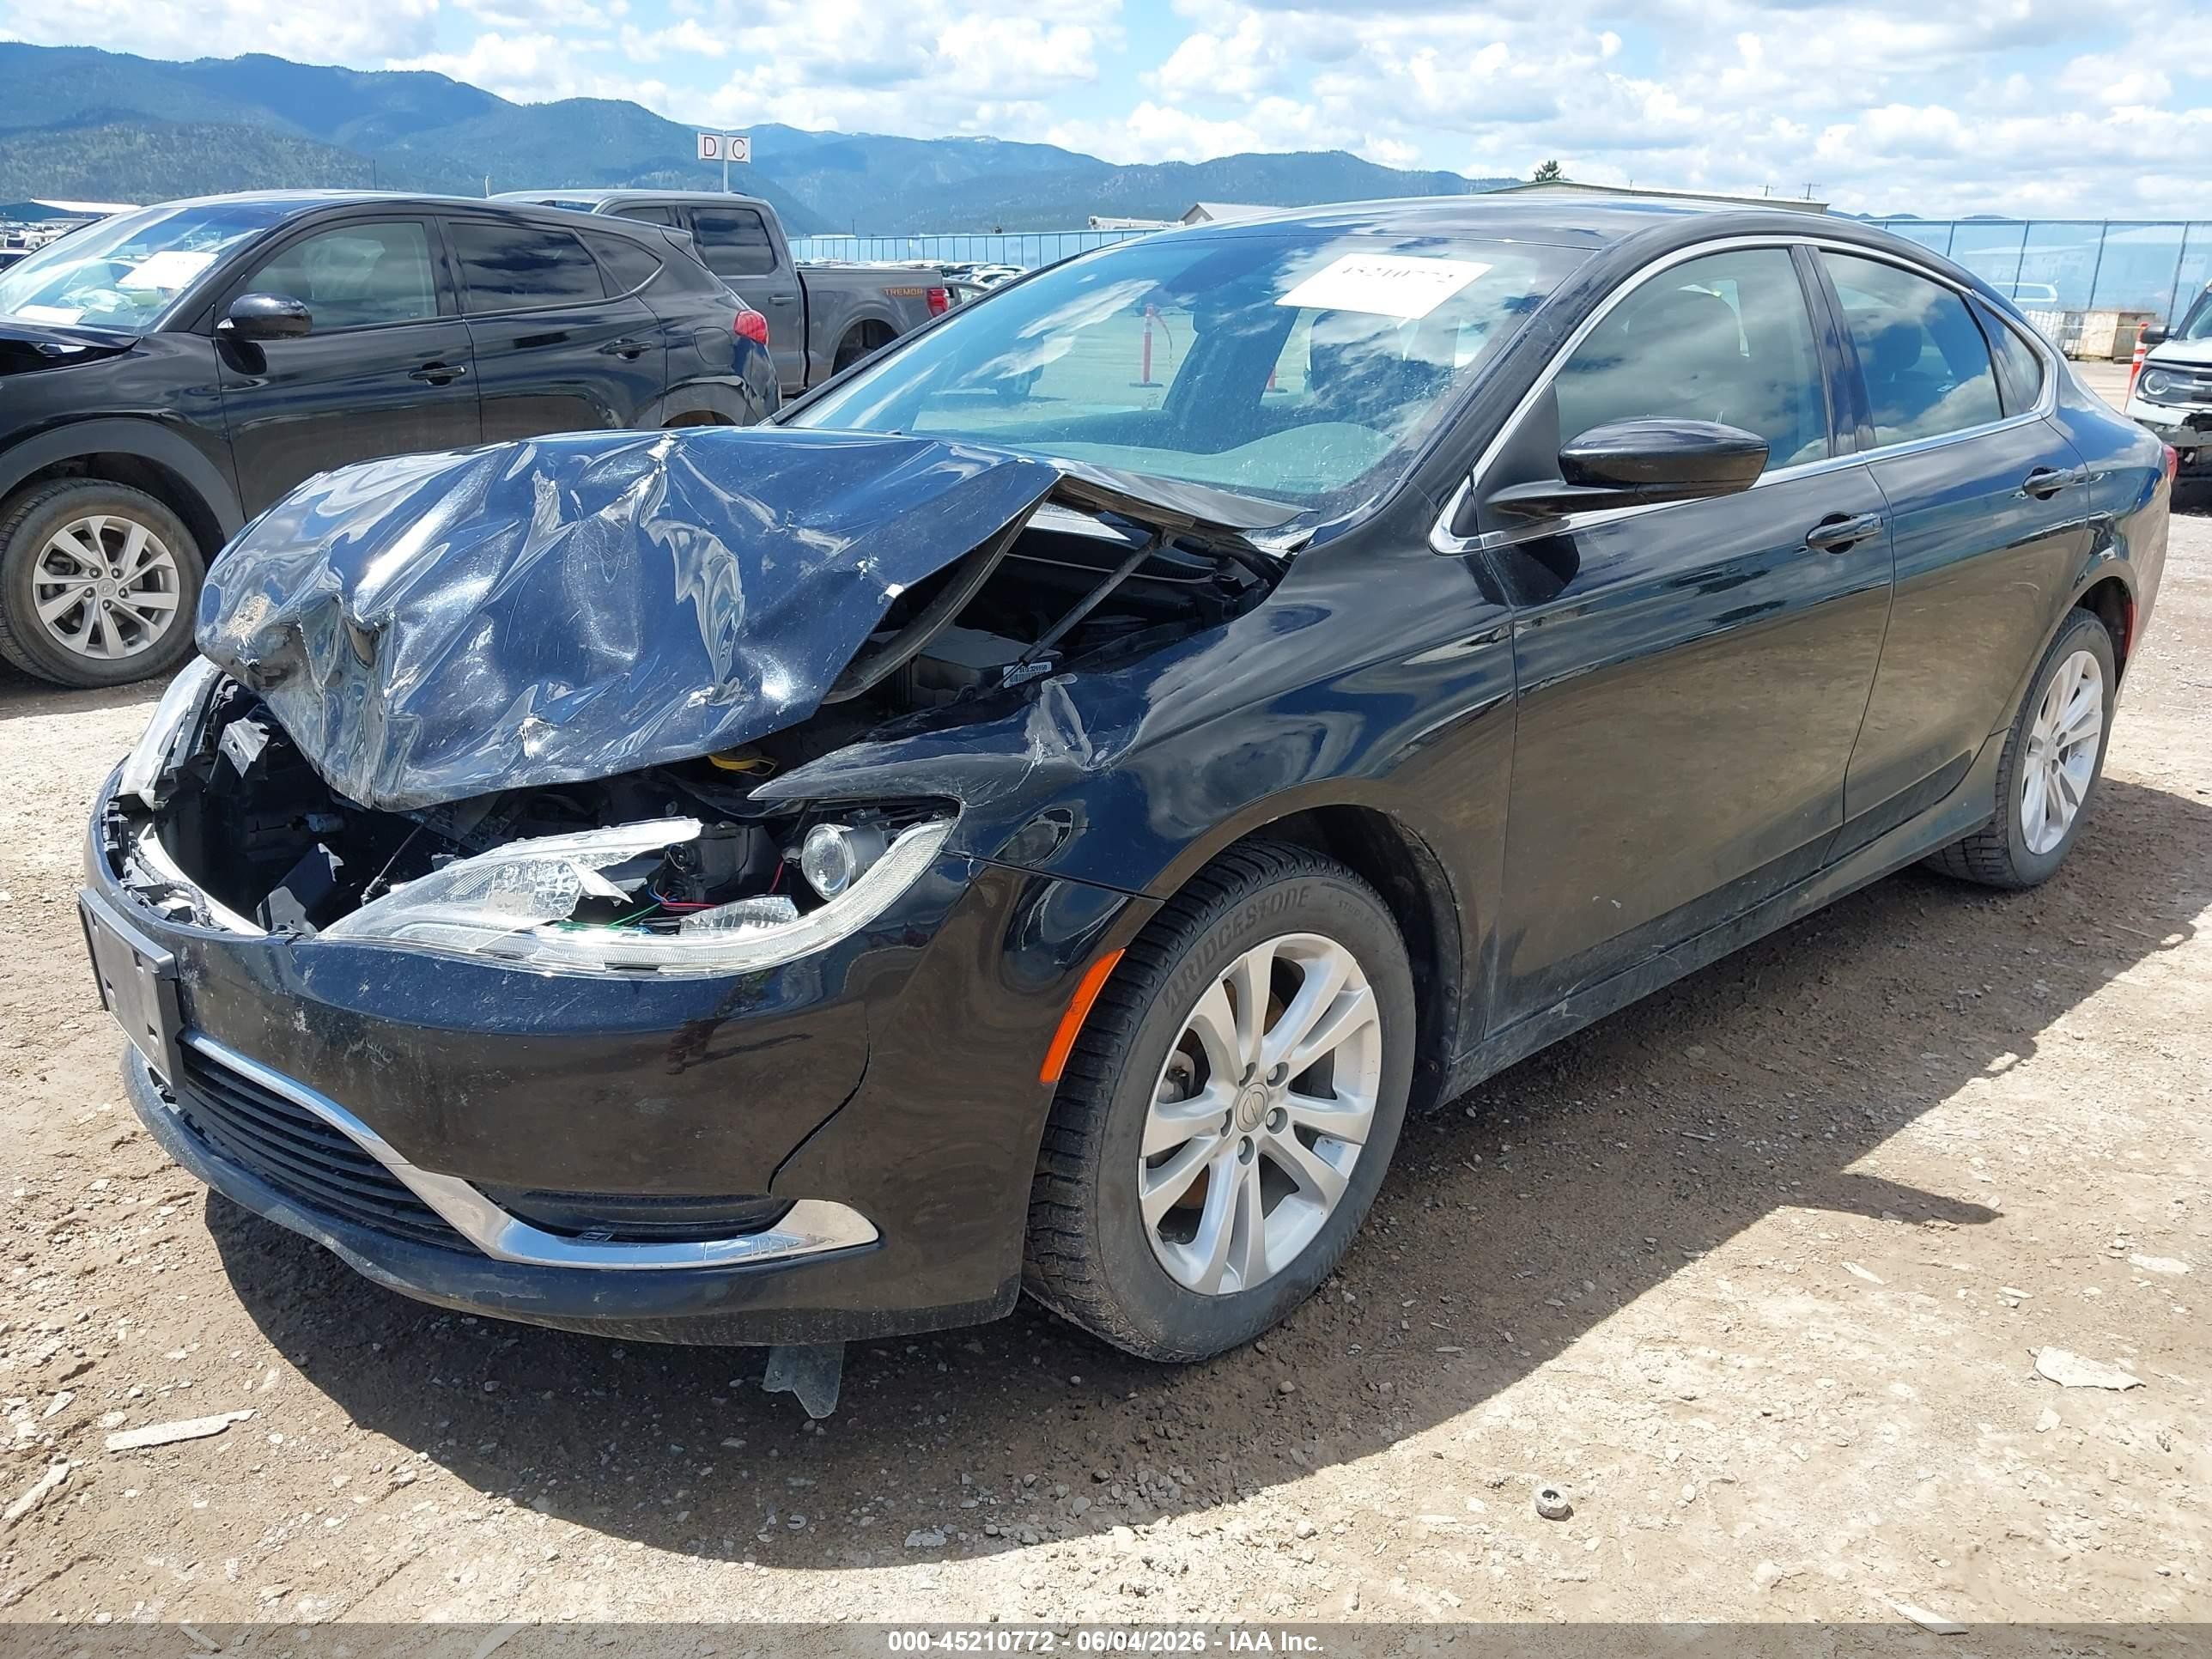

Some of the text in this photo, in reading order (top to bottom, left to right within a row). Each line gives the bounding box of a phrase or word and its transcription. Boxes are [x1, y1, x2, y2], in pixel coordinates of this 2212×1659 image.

[703, 137, 717, 157] D
[732, 139, 745, 160] C
[884, 288, 924, 296] TREMOR
